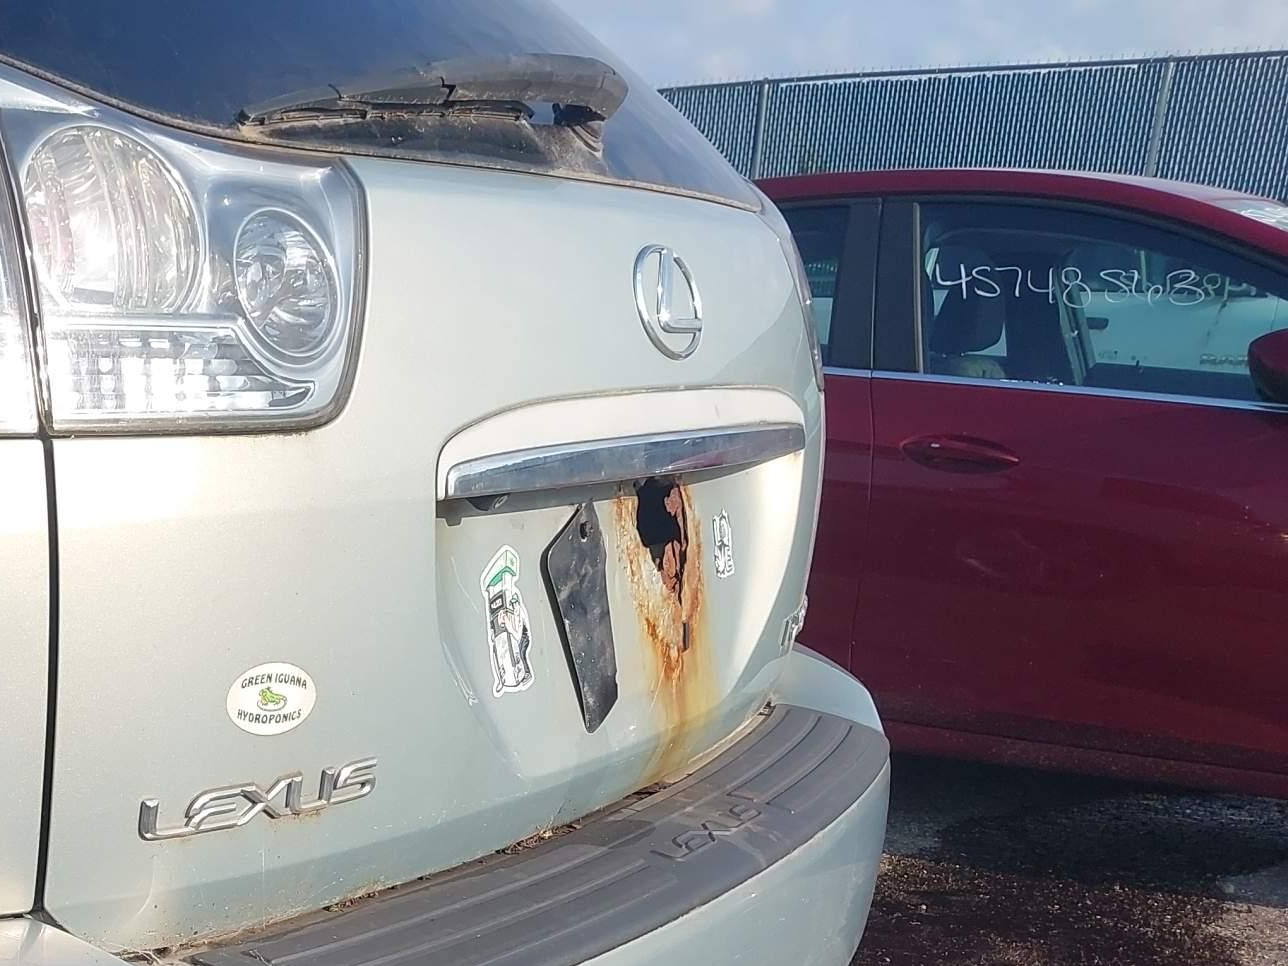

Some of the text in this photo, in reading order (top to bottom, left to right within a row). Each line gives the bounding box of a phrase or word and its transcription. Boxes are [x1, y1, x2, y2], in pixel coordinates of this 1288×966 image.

[240, 672, 308, 689] GREEN IGUANA
[237, 708, 302, 724] HYDROPONICS
[137, 756, 377, 842] LEXUS
[649, 803, 762, 860] LEXUS
